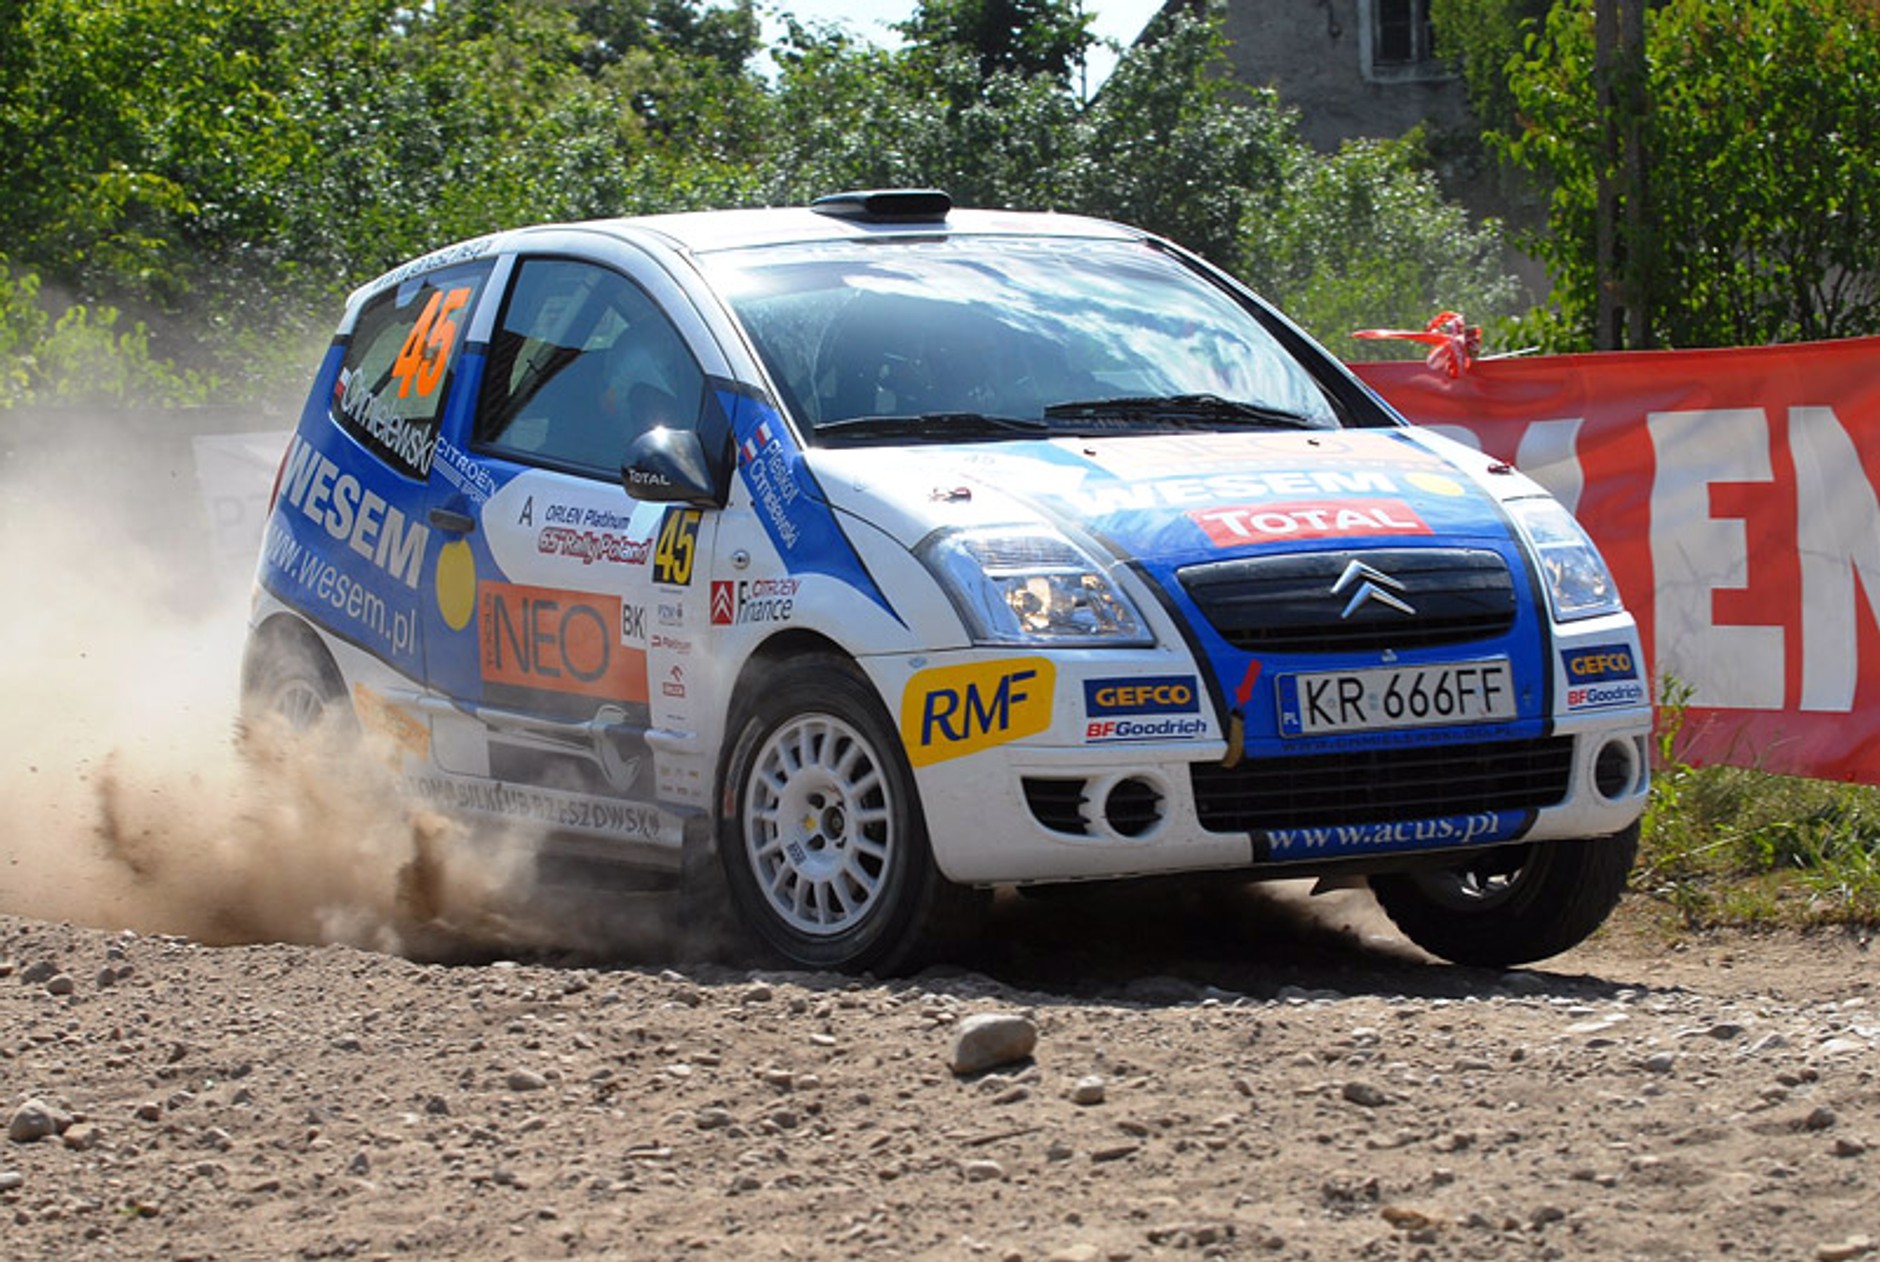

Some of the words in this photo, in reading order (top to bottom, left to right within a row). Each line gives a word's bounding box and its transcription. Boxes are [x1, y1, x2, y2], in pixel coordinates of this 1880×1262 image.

[391, 287, 471, 399] 45
[628, 469, 671, 486] TOTAL
[1077, 470, 1399, 512] WESEM
[279, 436, 430, 589] WESEM
[518, 495, 533, 527] A
[545, 504, 583, 525] ORLEN
[583, 509, 631, 530] Platinum
[1201, 502, 1419, 538] TOTAL
[654, 509, 700, 585] 45
[736, 580, 794, 623] Finance
[494, 595, 610, 683] NEO
[1569, 652, 1633, 675] GEFCO
[920, 670, 1037, 746] RMF
[1094, 685, 1191, 707] GEFCO
[1305, 676, 1367, 727] KR
[1383, 666, 1504, 719] 666FF
[1567, 684, 1644, 706] BFGoodrich
[1085, 718, 1207, 738] BFGoodrich
[1283, 710, 1300, 727] PL
[1268, 810, 1499, 851] www.acus.pl
